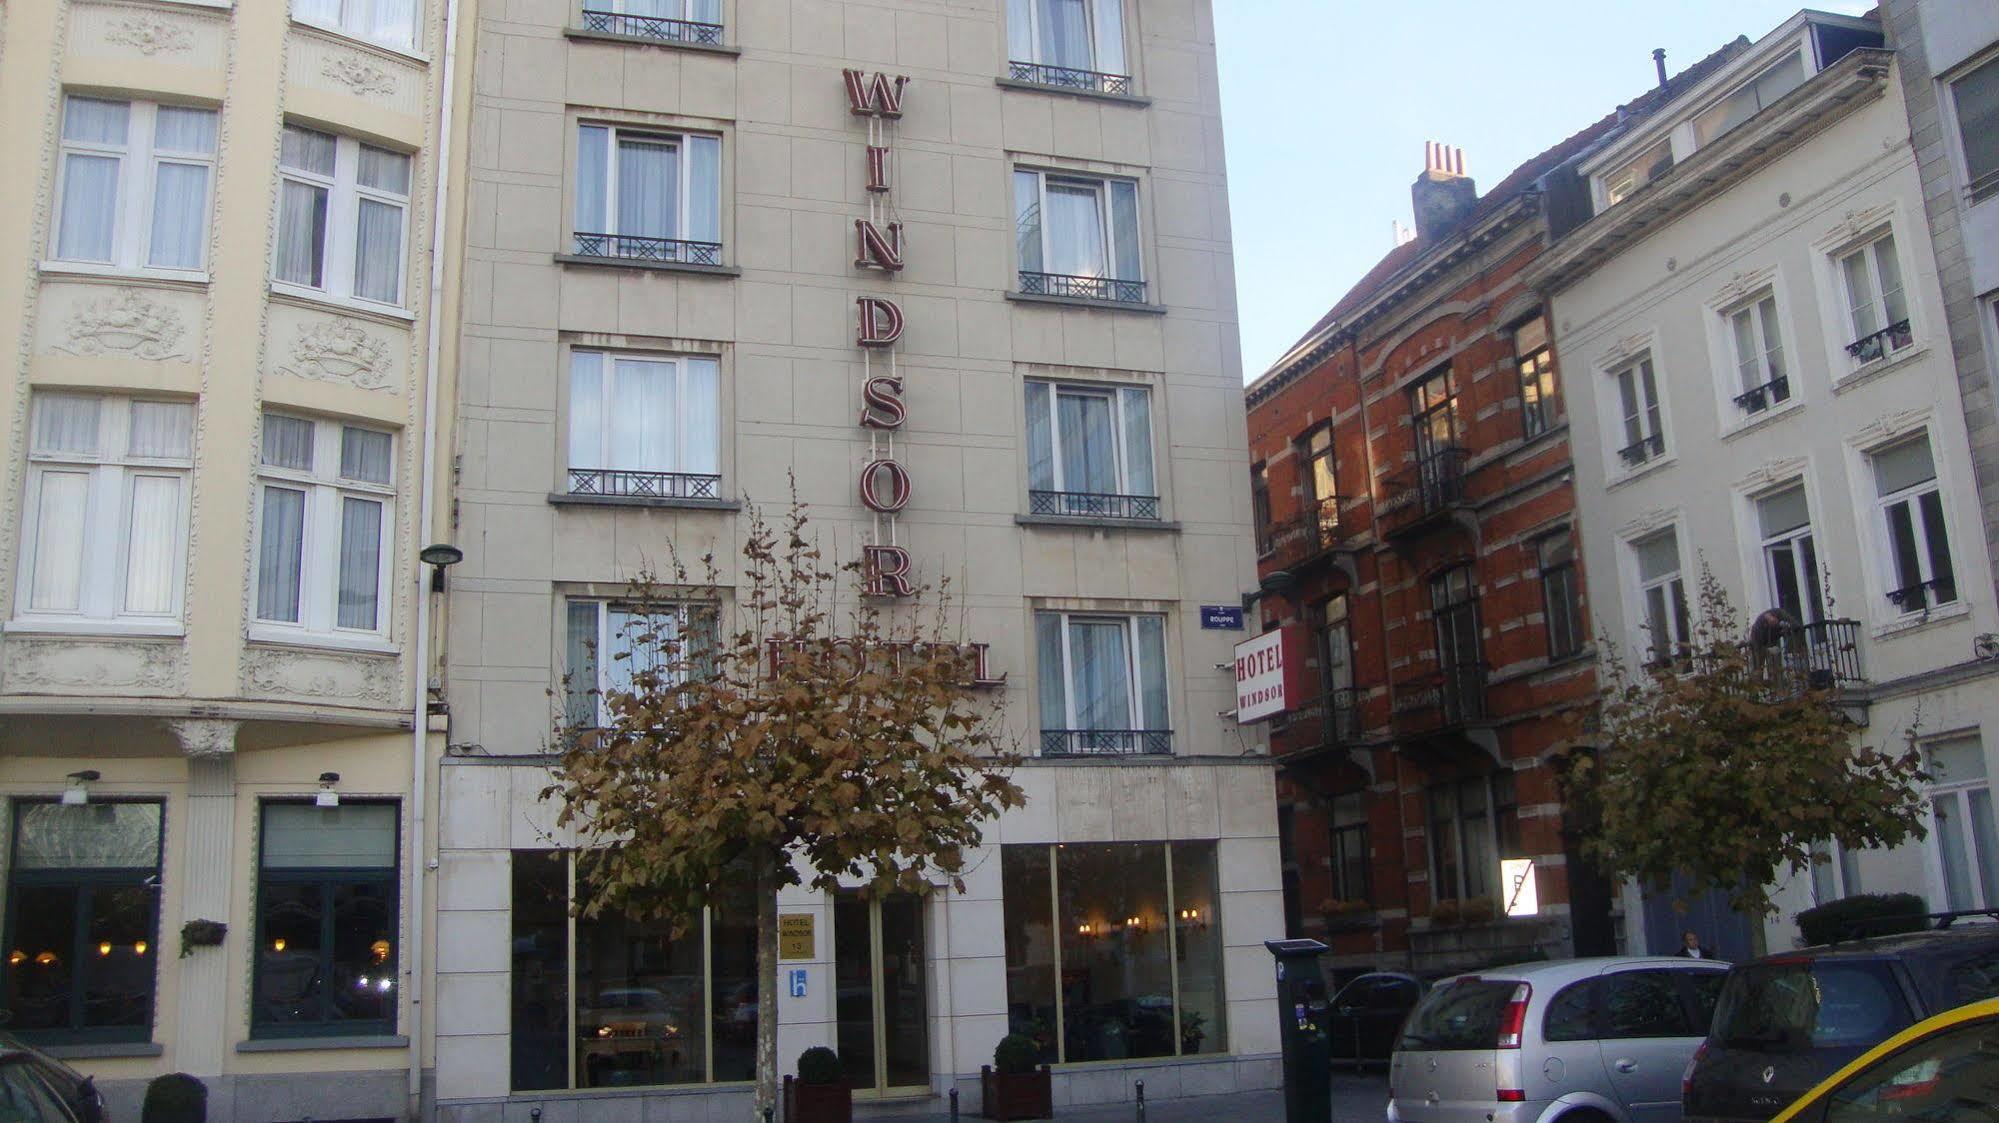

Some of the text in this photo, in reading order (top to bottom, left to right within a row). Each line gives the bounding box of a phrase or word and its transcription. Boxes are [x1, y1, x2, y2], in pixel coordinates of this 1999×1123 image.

[842, 68, 914, 600] WINDSOR
[1236, 645, 1283, 682] HOTEL
[1239, 684, 1283, 709] WINDSOR
[783, 918, 809, 926] HOTEL
